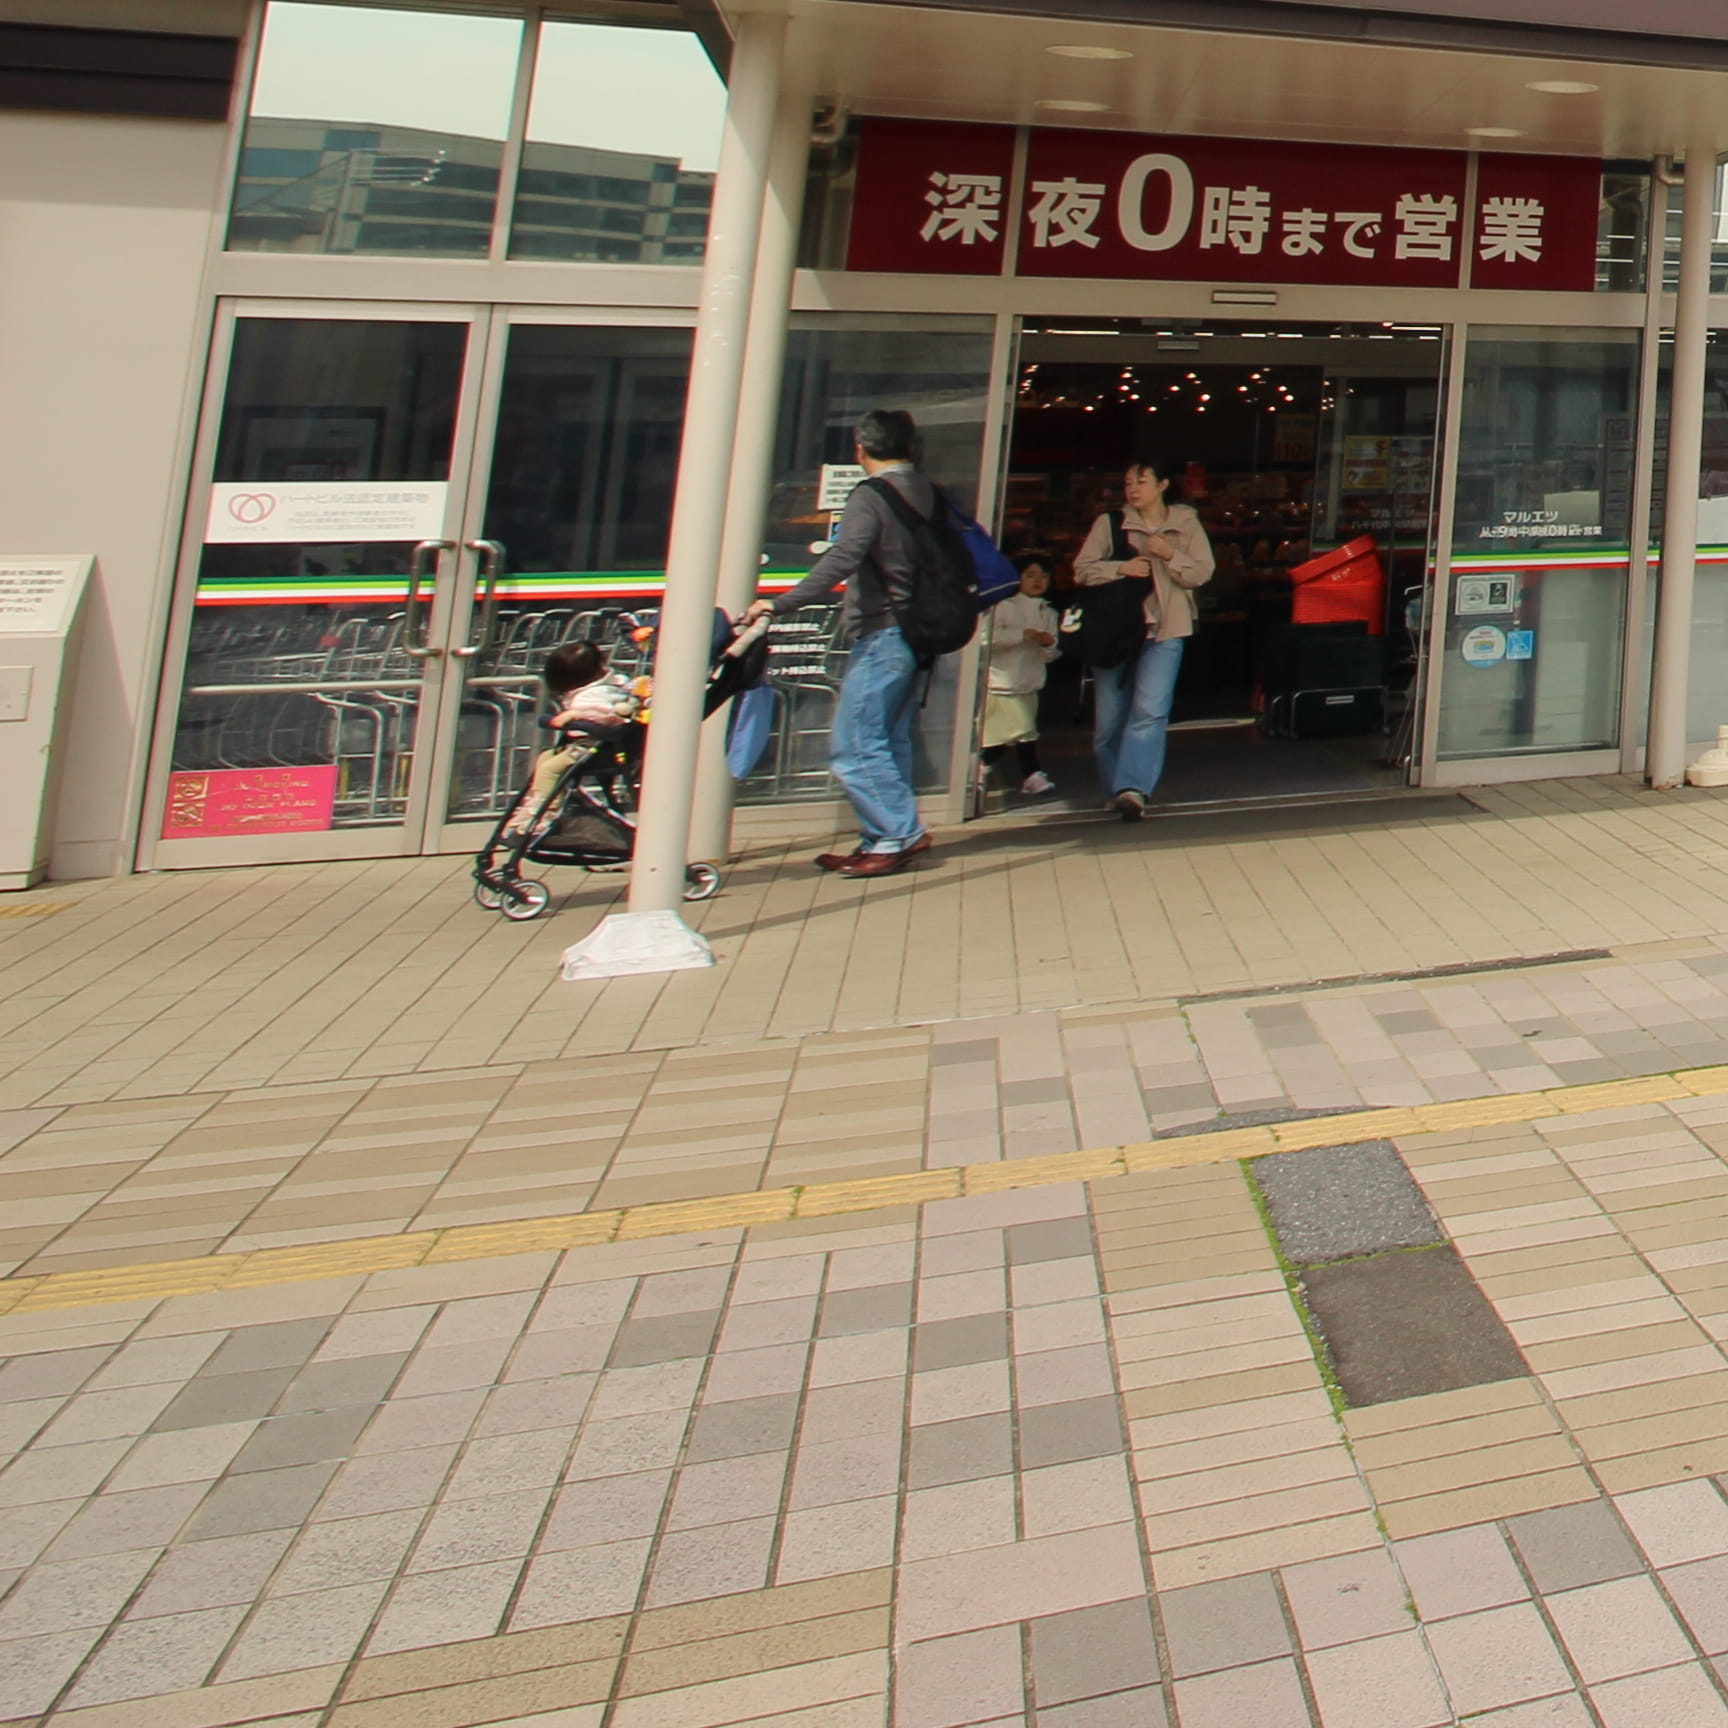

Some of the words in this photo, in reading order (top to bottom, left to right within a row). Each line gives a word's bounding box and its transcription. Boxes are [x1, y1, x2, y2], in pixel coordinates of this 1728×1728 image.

[920, 153, 1546, 264] 深夜0時まで営業
